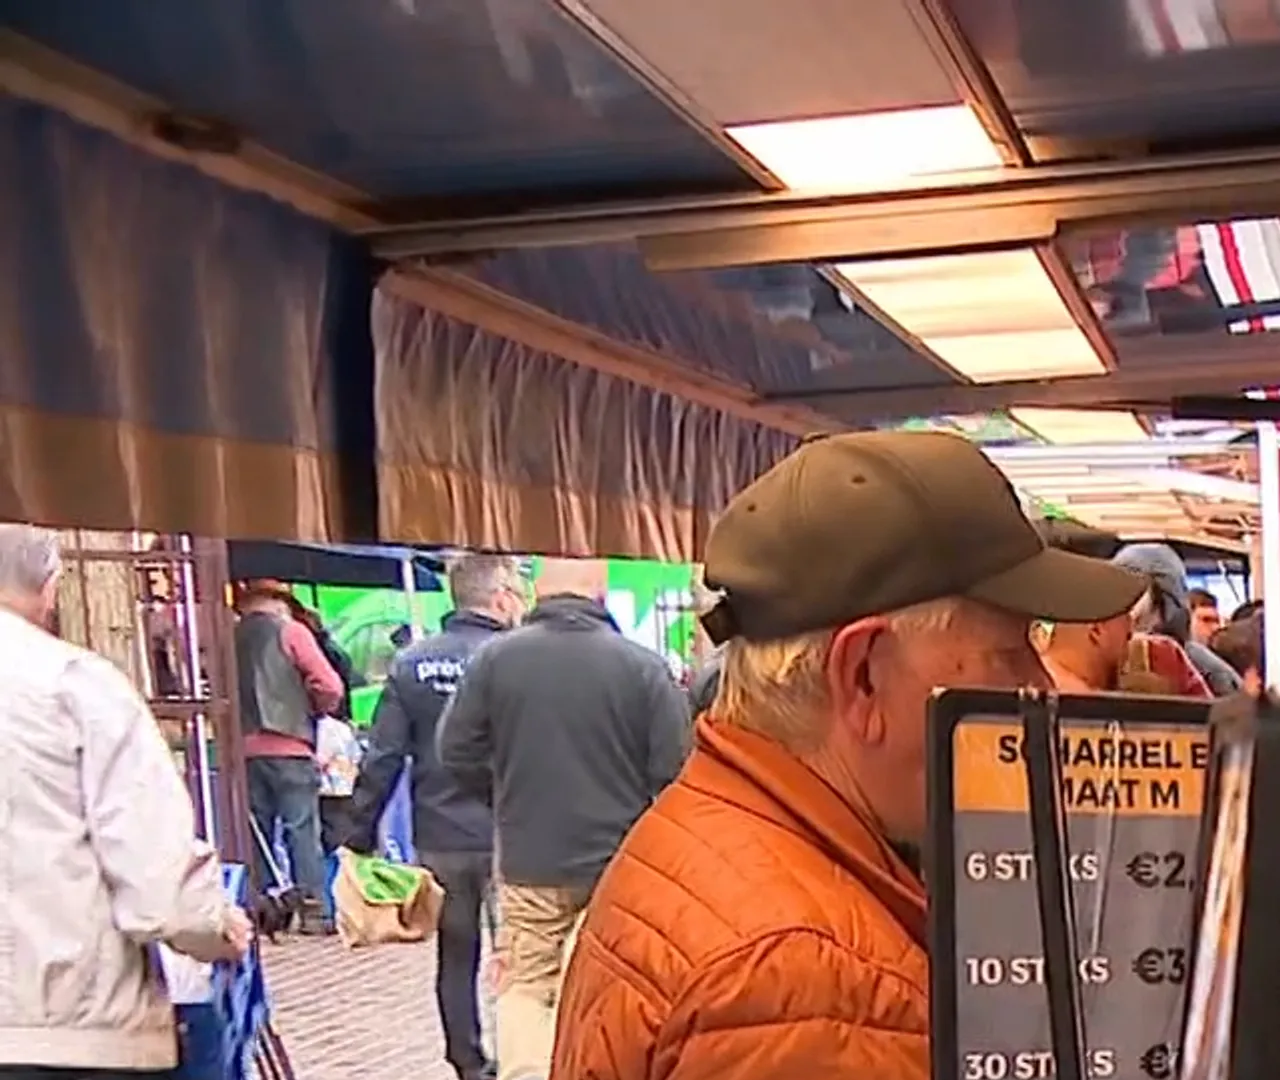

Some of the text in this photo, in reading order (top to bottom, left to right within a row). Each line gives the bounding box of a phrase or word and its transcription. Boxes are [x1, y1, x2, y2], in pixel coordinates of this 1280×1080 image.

[997, 733, 1183, 770] SARREL
[1151, 780, 1180, 809] M
[966, 851, 988, 881] 6
[994, 852, 1099, 881] STS
[966, 957, 1002, 985] 10
[1010, 957, 1110, 985] STS
[964, 1053, 1008, 1080] 30
[1014, 1050, 1117, 1080] STS
